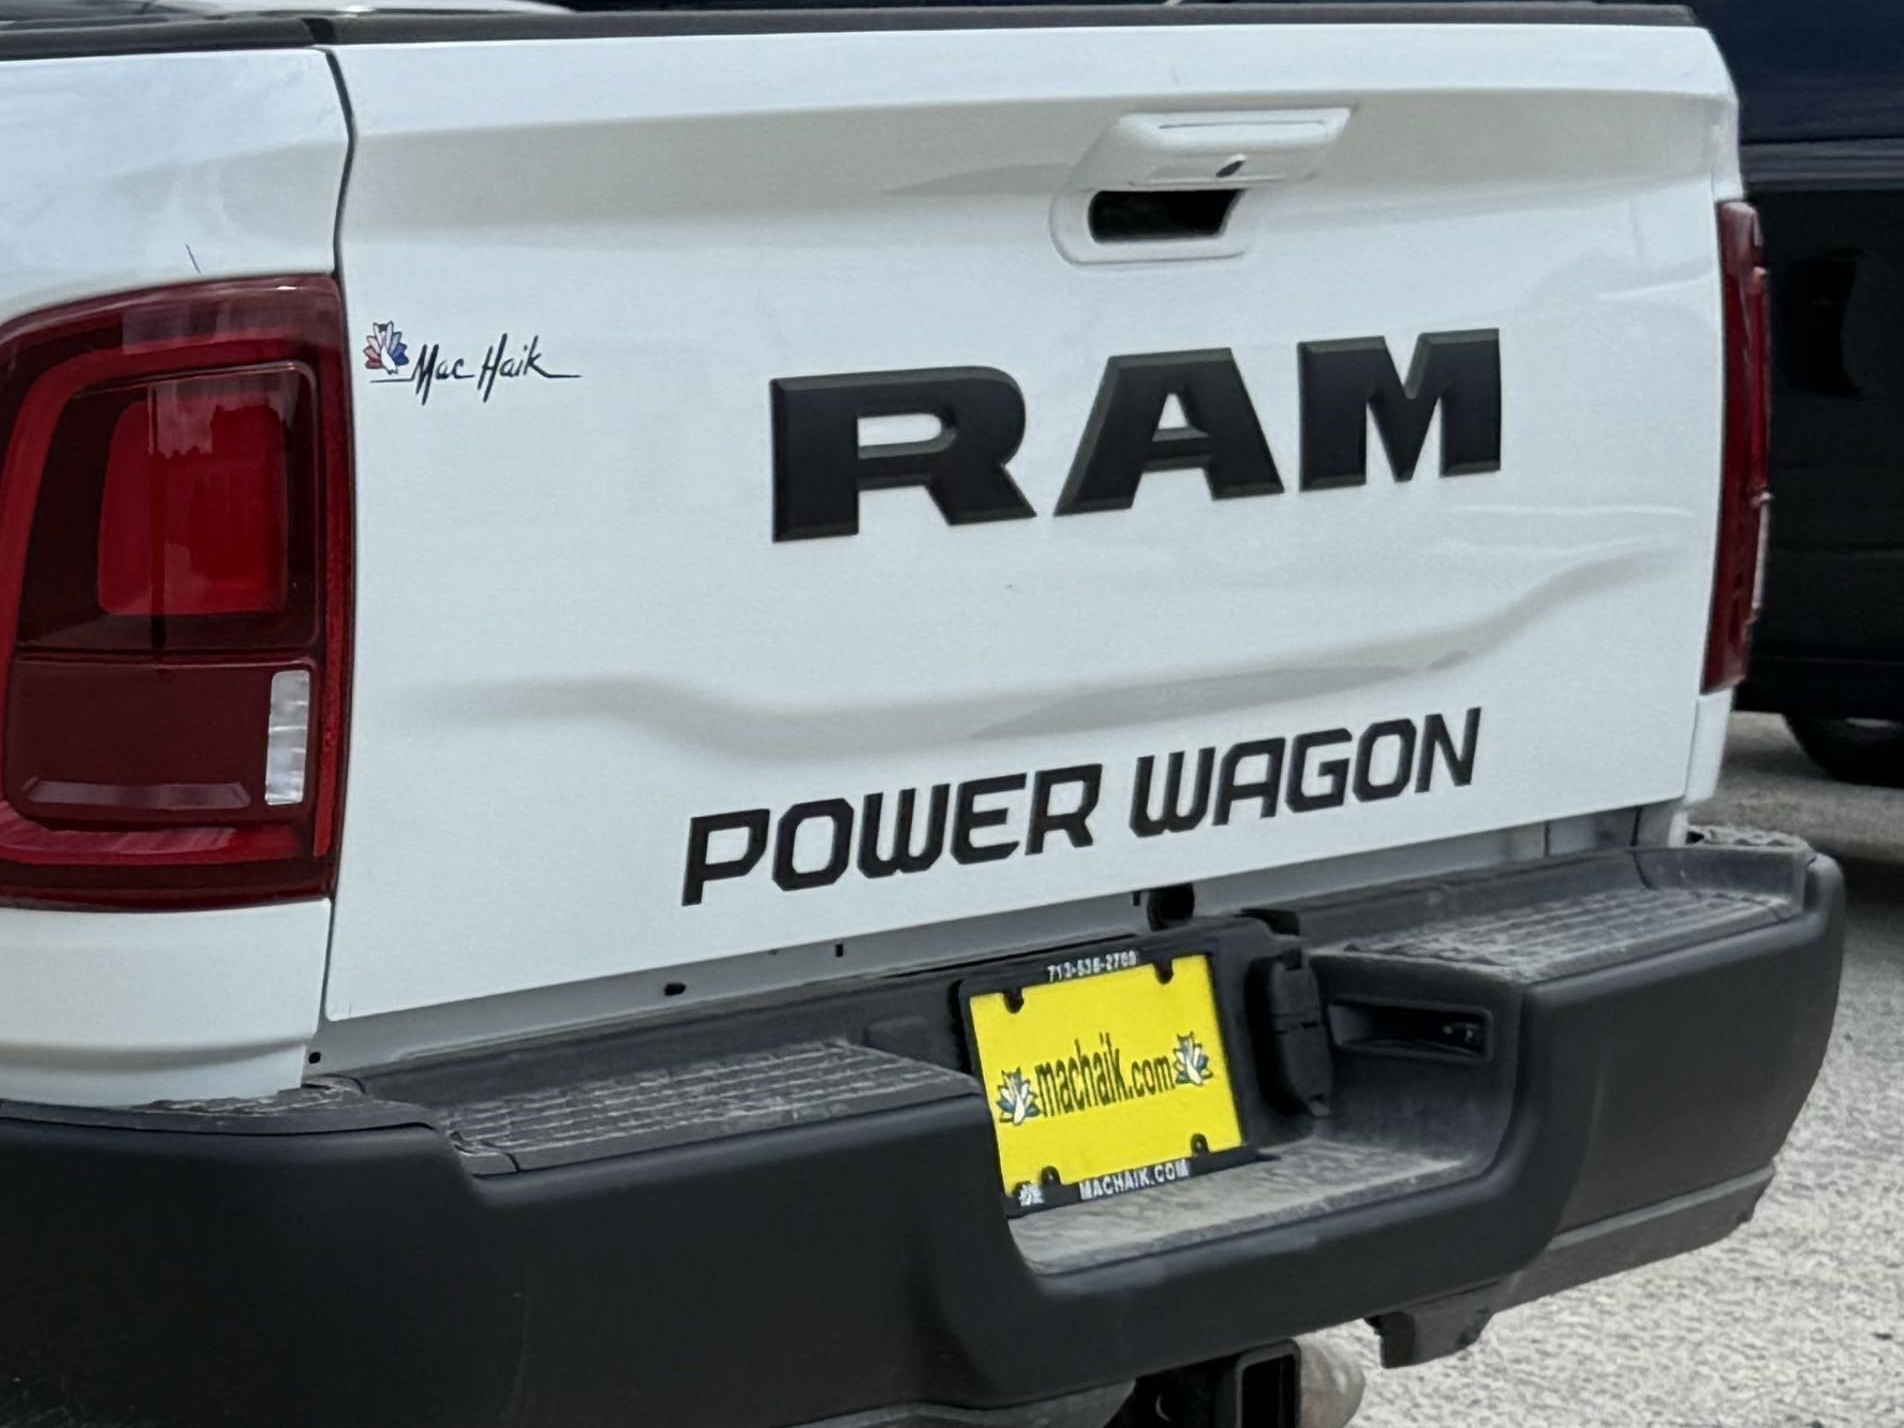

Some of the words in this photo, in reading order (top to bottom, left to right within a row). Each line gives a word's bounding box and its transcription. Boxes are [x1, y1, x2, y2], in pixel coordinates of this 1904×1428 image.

[370, 343, 476, 406] Mac
[476, 332, 581, 403] Haik
[769, 327, 1502, 543] RAM
[680, 762, 1103, 907] POWER
[1129, 706, 1482, 838] WAGON
[1034, 1031, 1177, 1118] machaik.com
[1078, 1159, 1191, 1201] MACHAIK.COM
